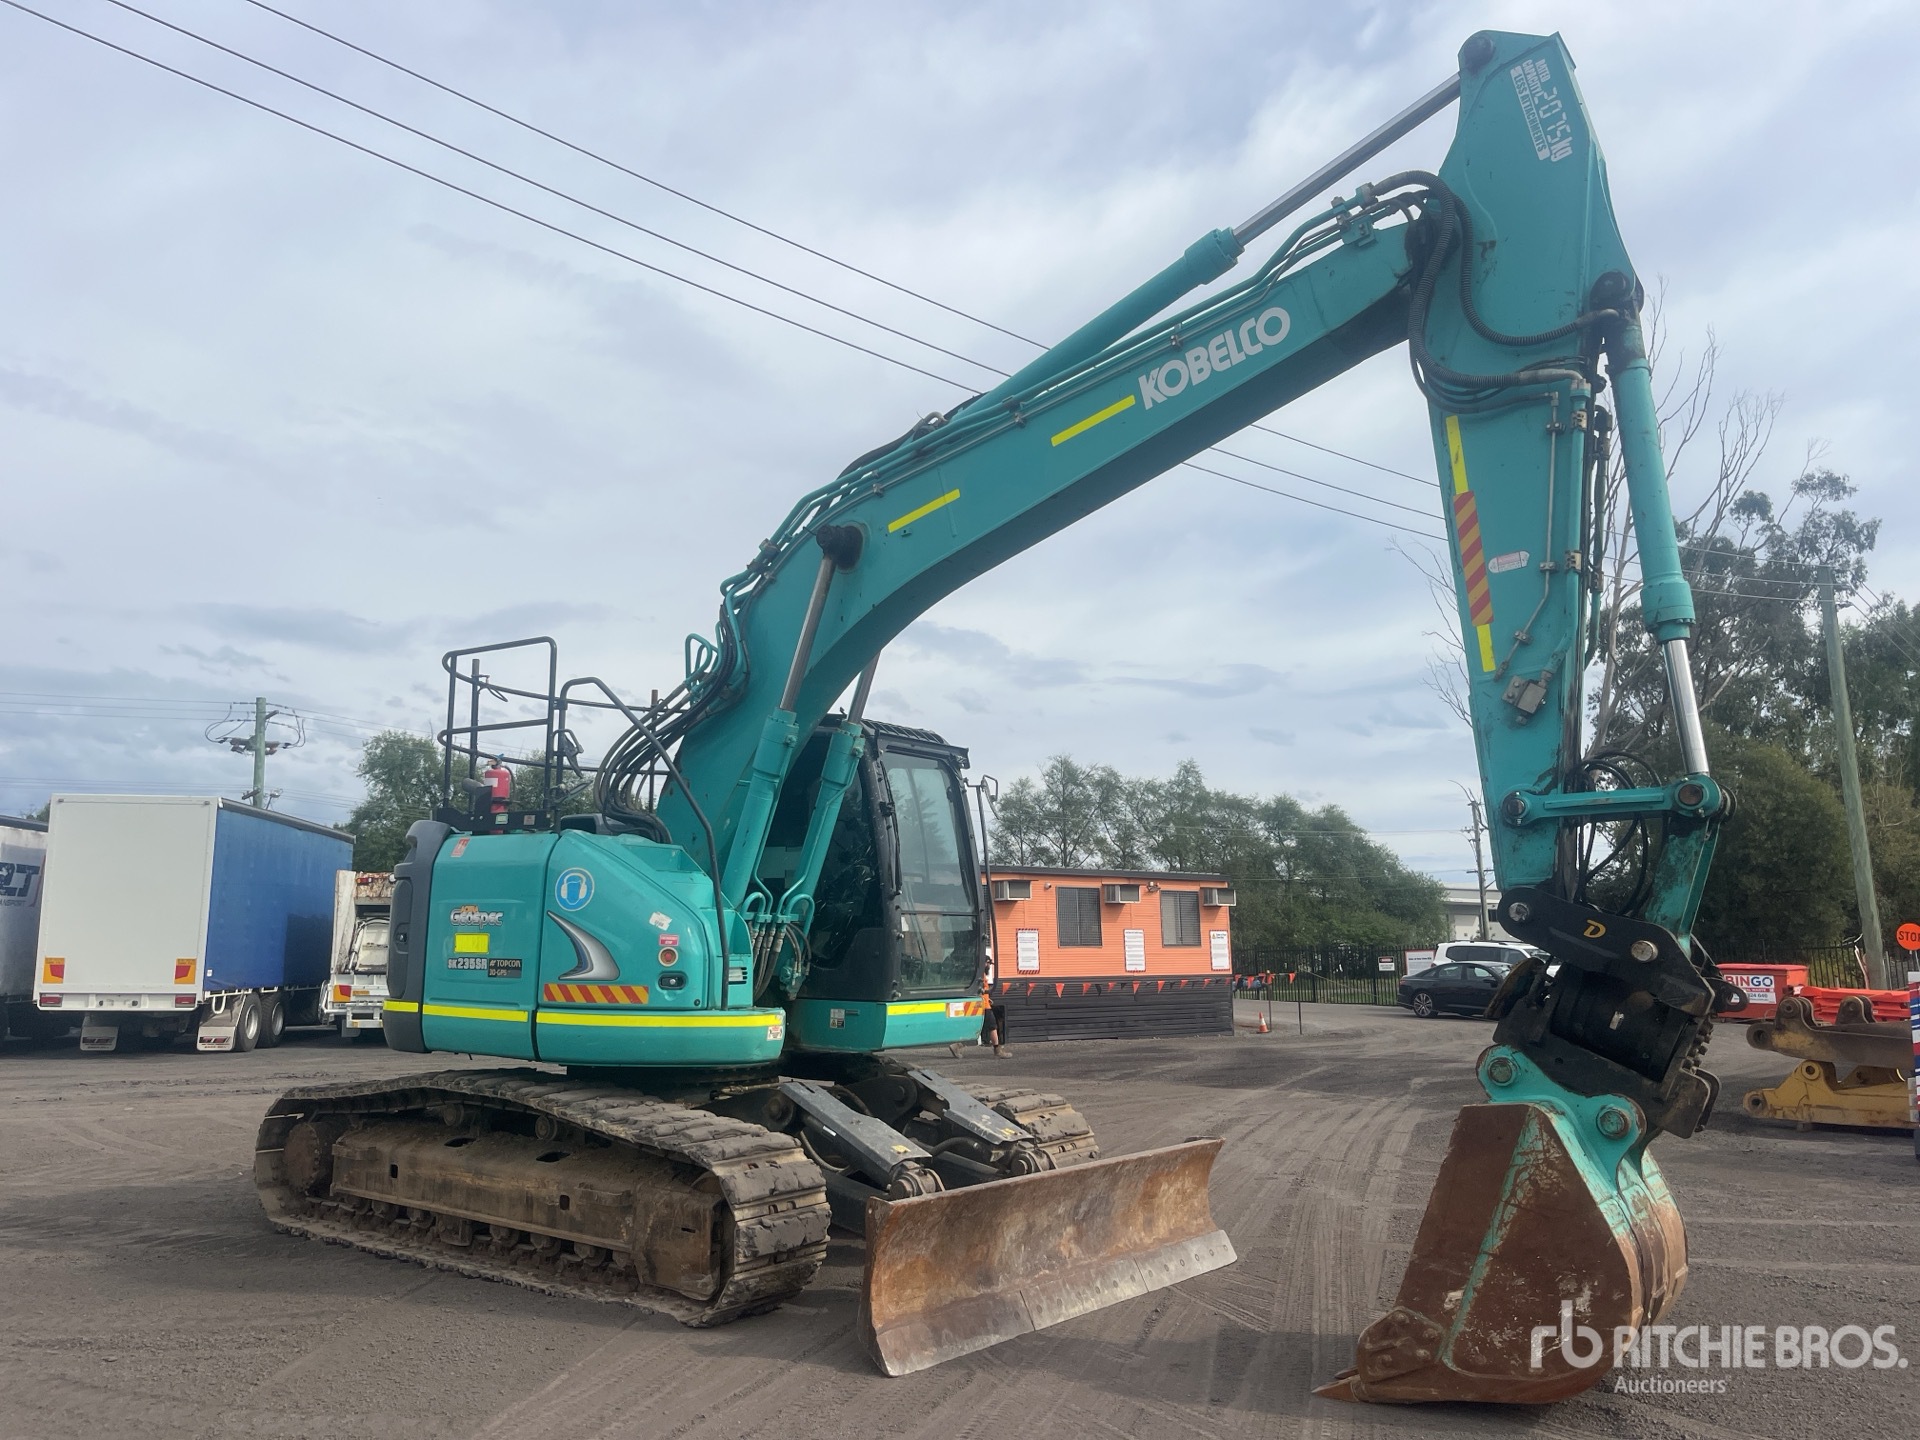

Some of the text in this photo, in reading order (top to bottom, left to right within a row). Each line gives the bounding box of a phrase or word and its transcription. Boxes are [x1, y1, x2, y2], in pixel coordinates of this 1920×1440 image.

[1522, 59, 1545, 97] CAPACITY
[1535, 58, 1551, 83] RATED
[1513, 73, 1547, 152] LESS ATTACHMENTS
[1138, 307, 1291, 410] KOBELCO
[1725, 976, 1773, 987] BINGO
